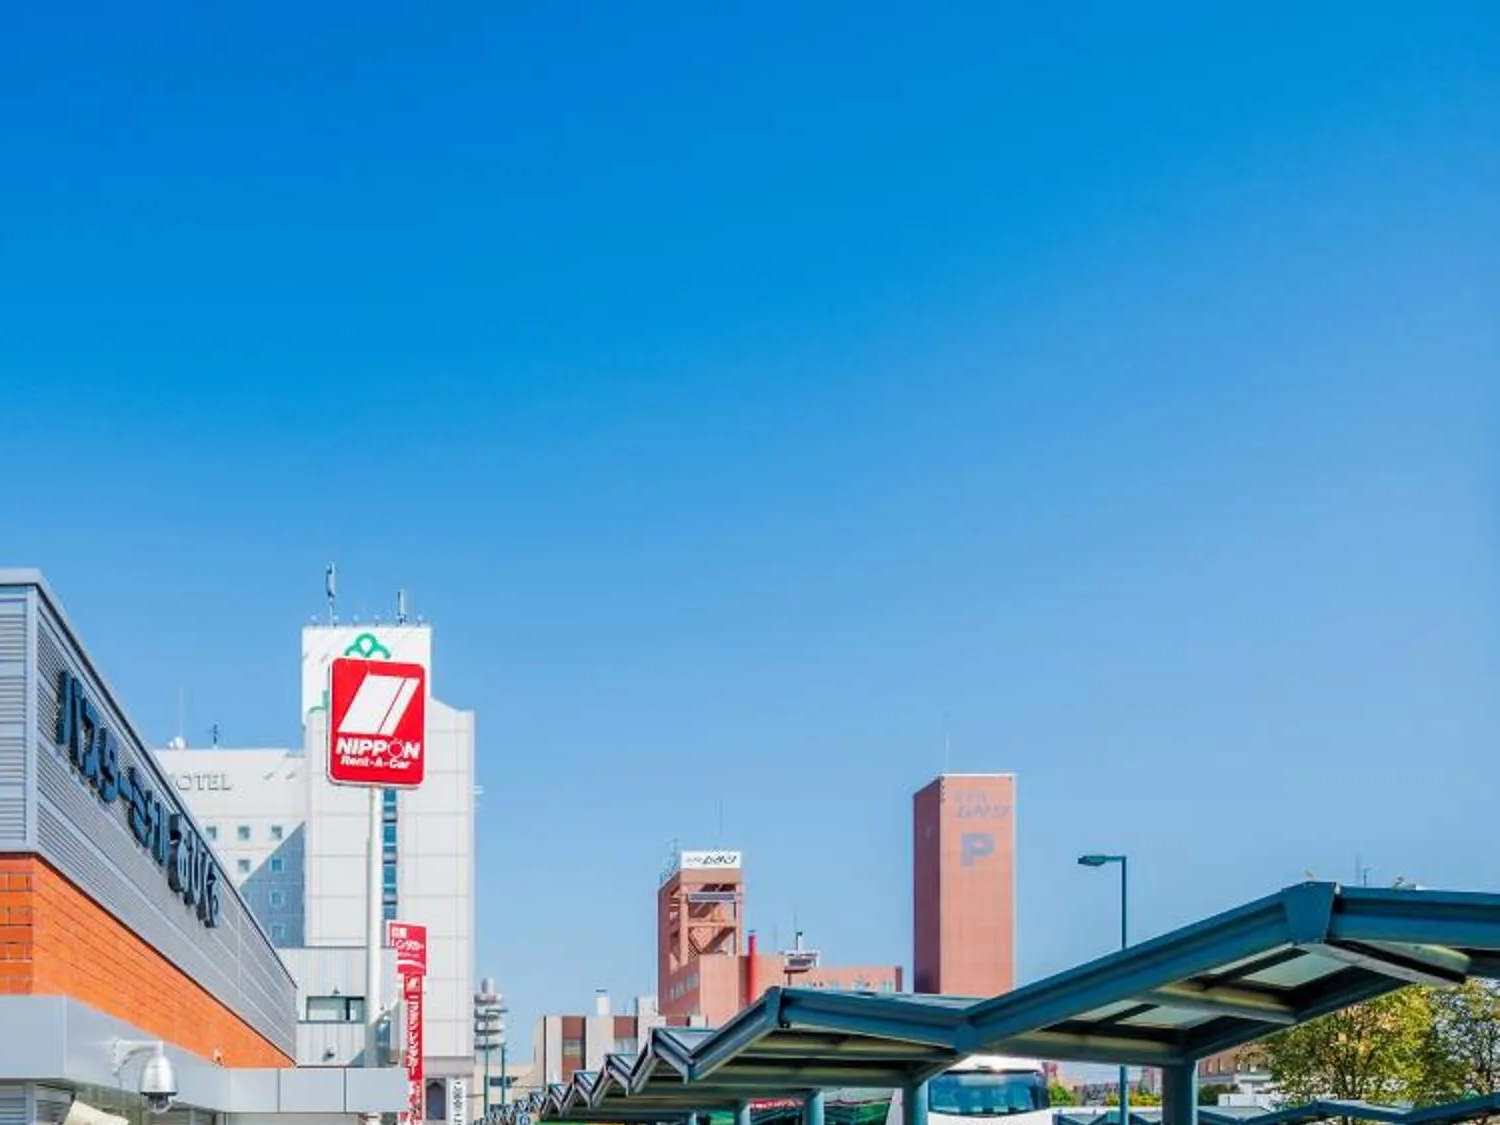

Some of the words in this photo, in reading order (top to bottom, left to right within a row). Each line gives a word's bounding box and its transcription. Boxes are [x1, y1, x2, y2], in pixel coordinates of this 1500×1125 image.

[336, 736, 420, 759] NIPPON
[340, 756, 412, 770] Rent-A-Car
[171, 773, 232, 791] OTEL
[961, 833, 995, 866] P
